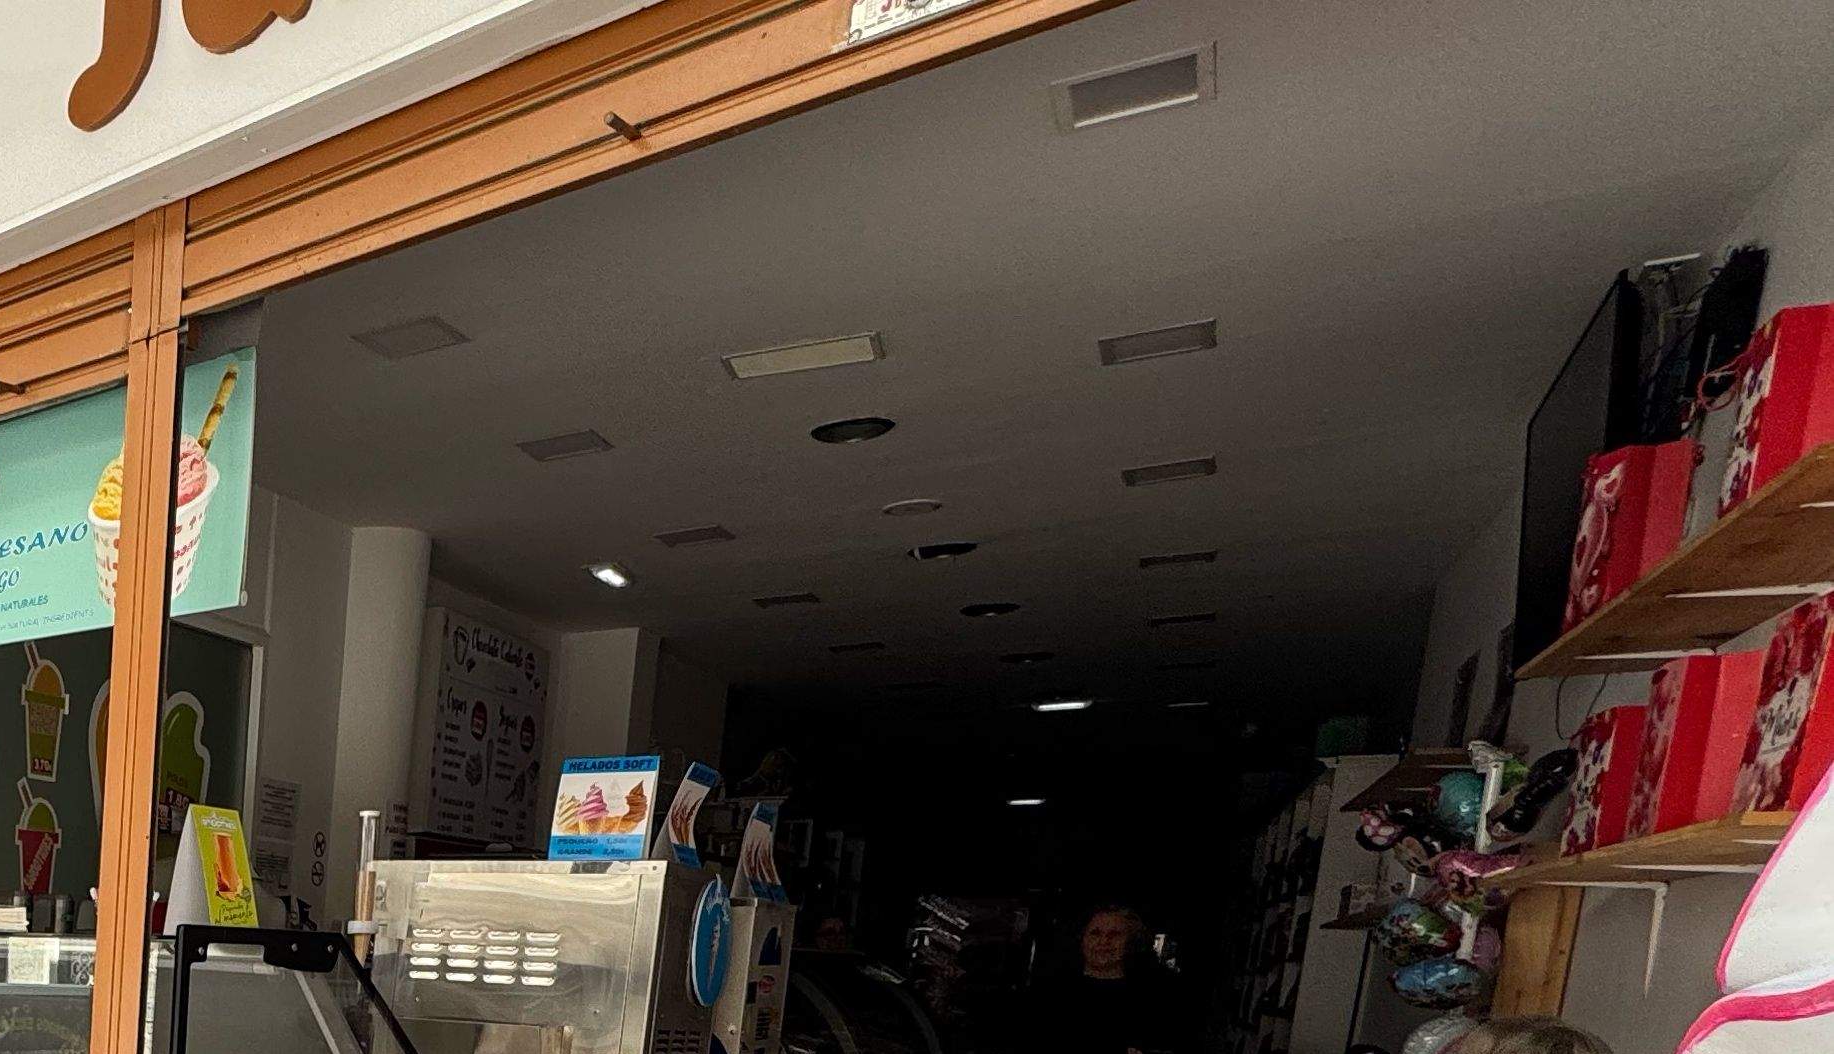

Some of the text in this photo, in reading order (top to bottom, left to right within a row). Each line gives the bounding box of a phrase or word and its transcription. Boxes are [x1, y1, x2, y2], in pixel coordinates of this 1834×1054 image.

[0, 595, 49, 613] NATURALES
[568, 759, 653, 770] HELADOS SOFT
